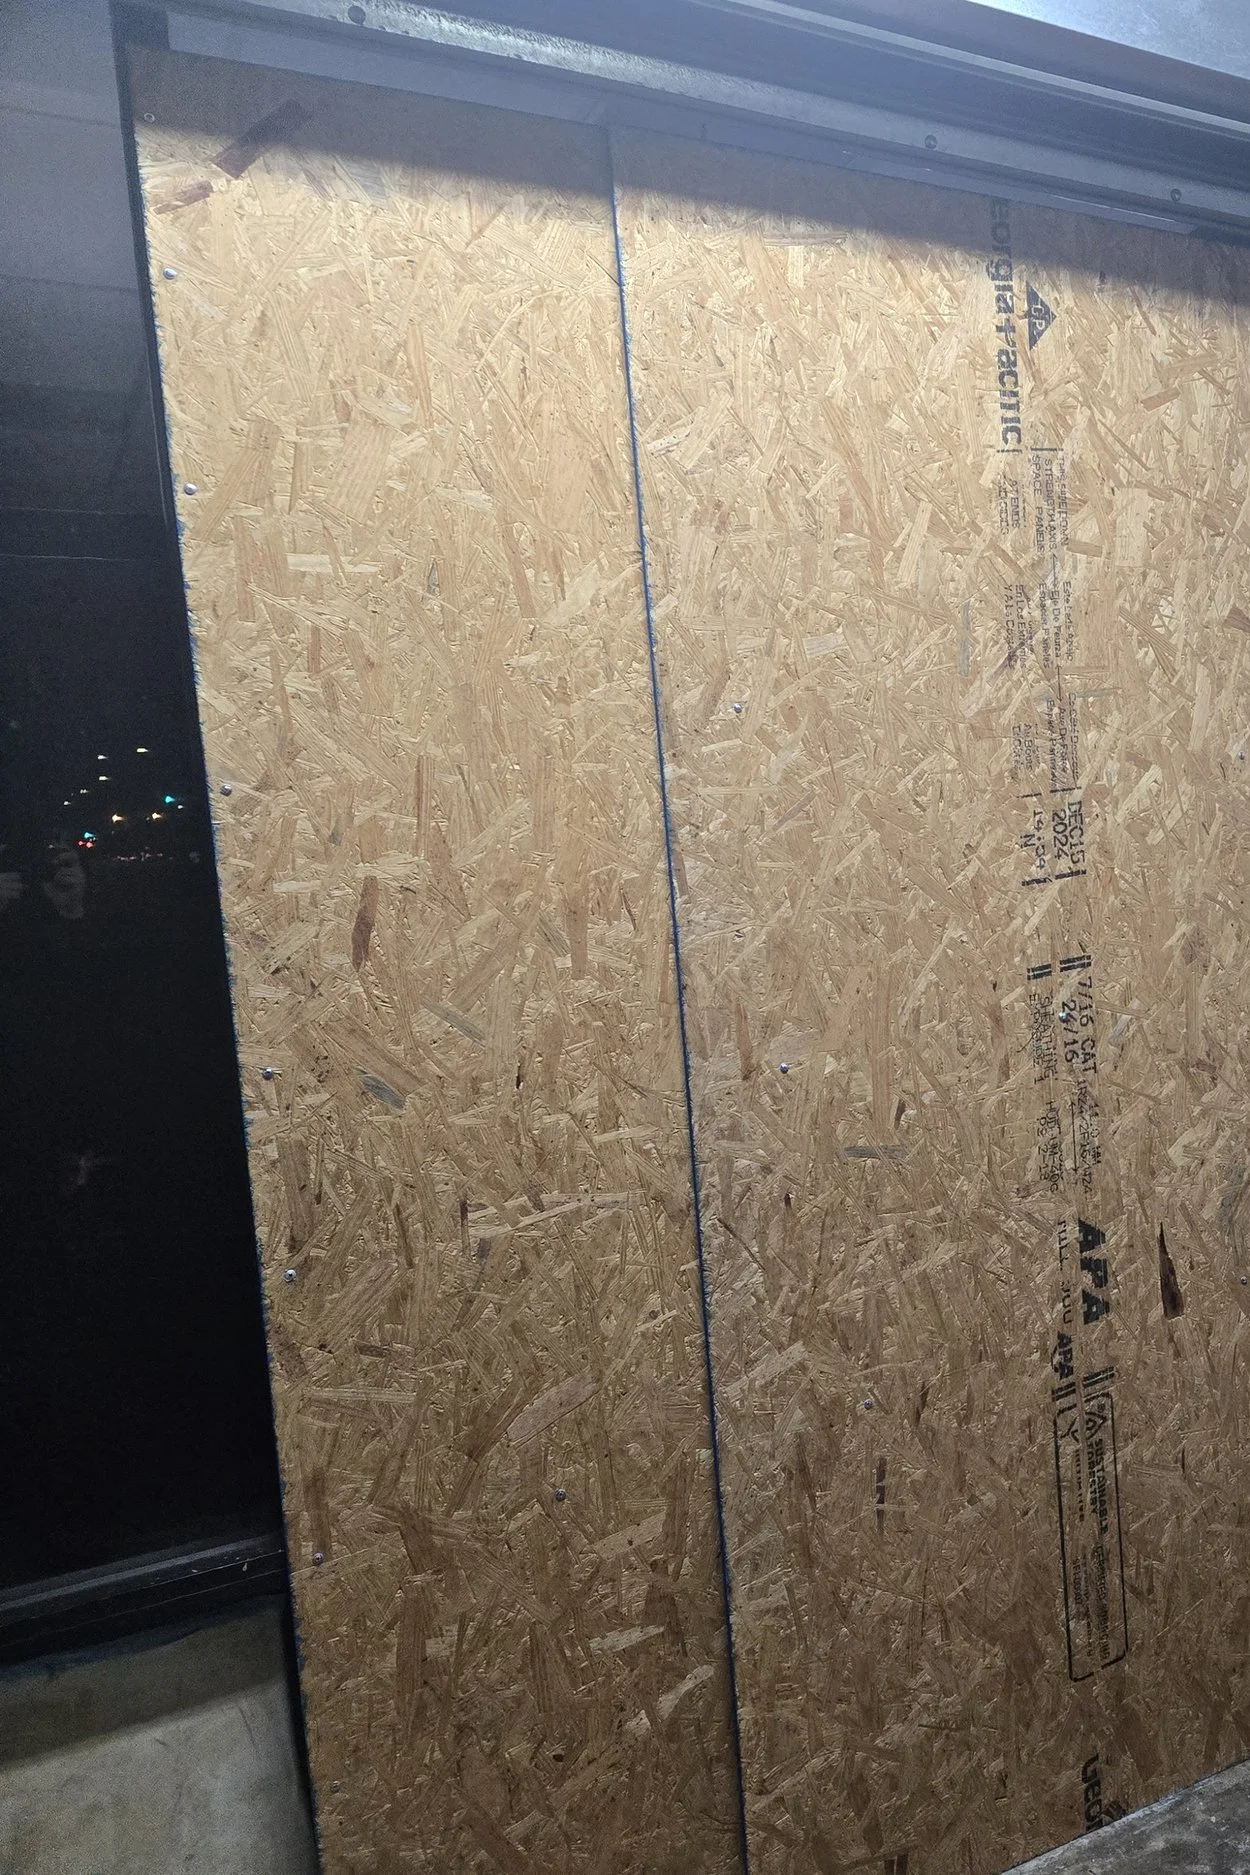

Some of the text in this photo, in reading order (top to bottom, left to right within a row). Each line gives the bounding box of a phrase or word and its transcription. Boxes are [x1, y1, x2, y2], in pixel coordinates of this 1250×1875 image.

[1031, 454, 1042, 497] SPACE
[1052, 809, 1069, 861] 2024
[1067, 800, 1086, 865] DEC15
[1059, 1000, 1079, 1064] 24/16
[1077, 976, 1097, 1074] 7/16 CAT
[1078, 1219, 1110, 1326] APA
[1057, 1331, 1077, 1381] APA
[1095, 1438, 1109, 1536] SUSTAINABLE
